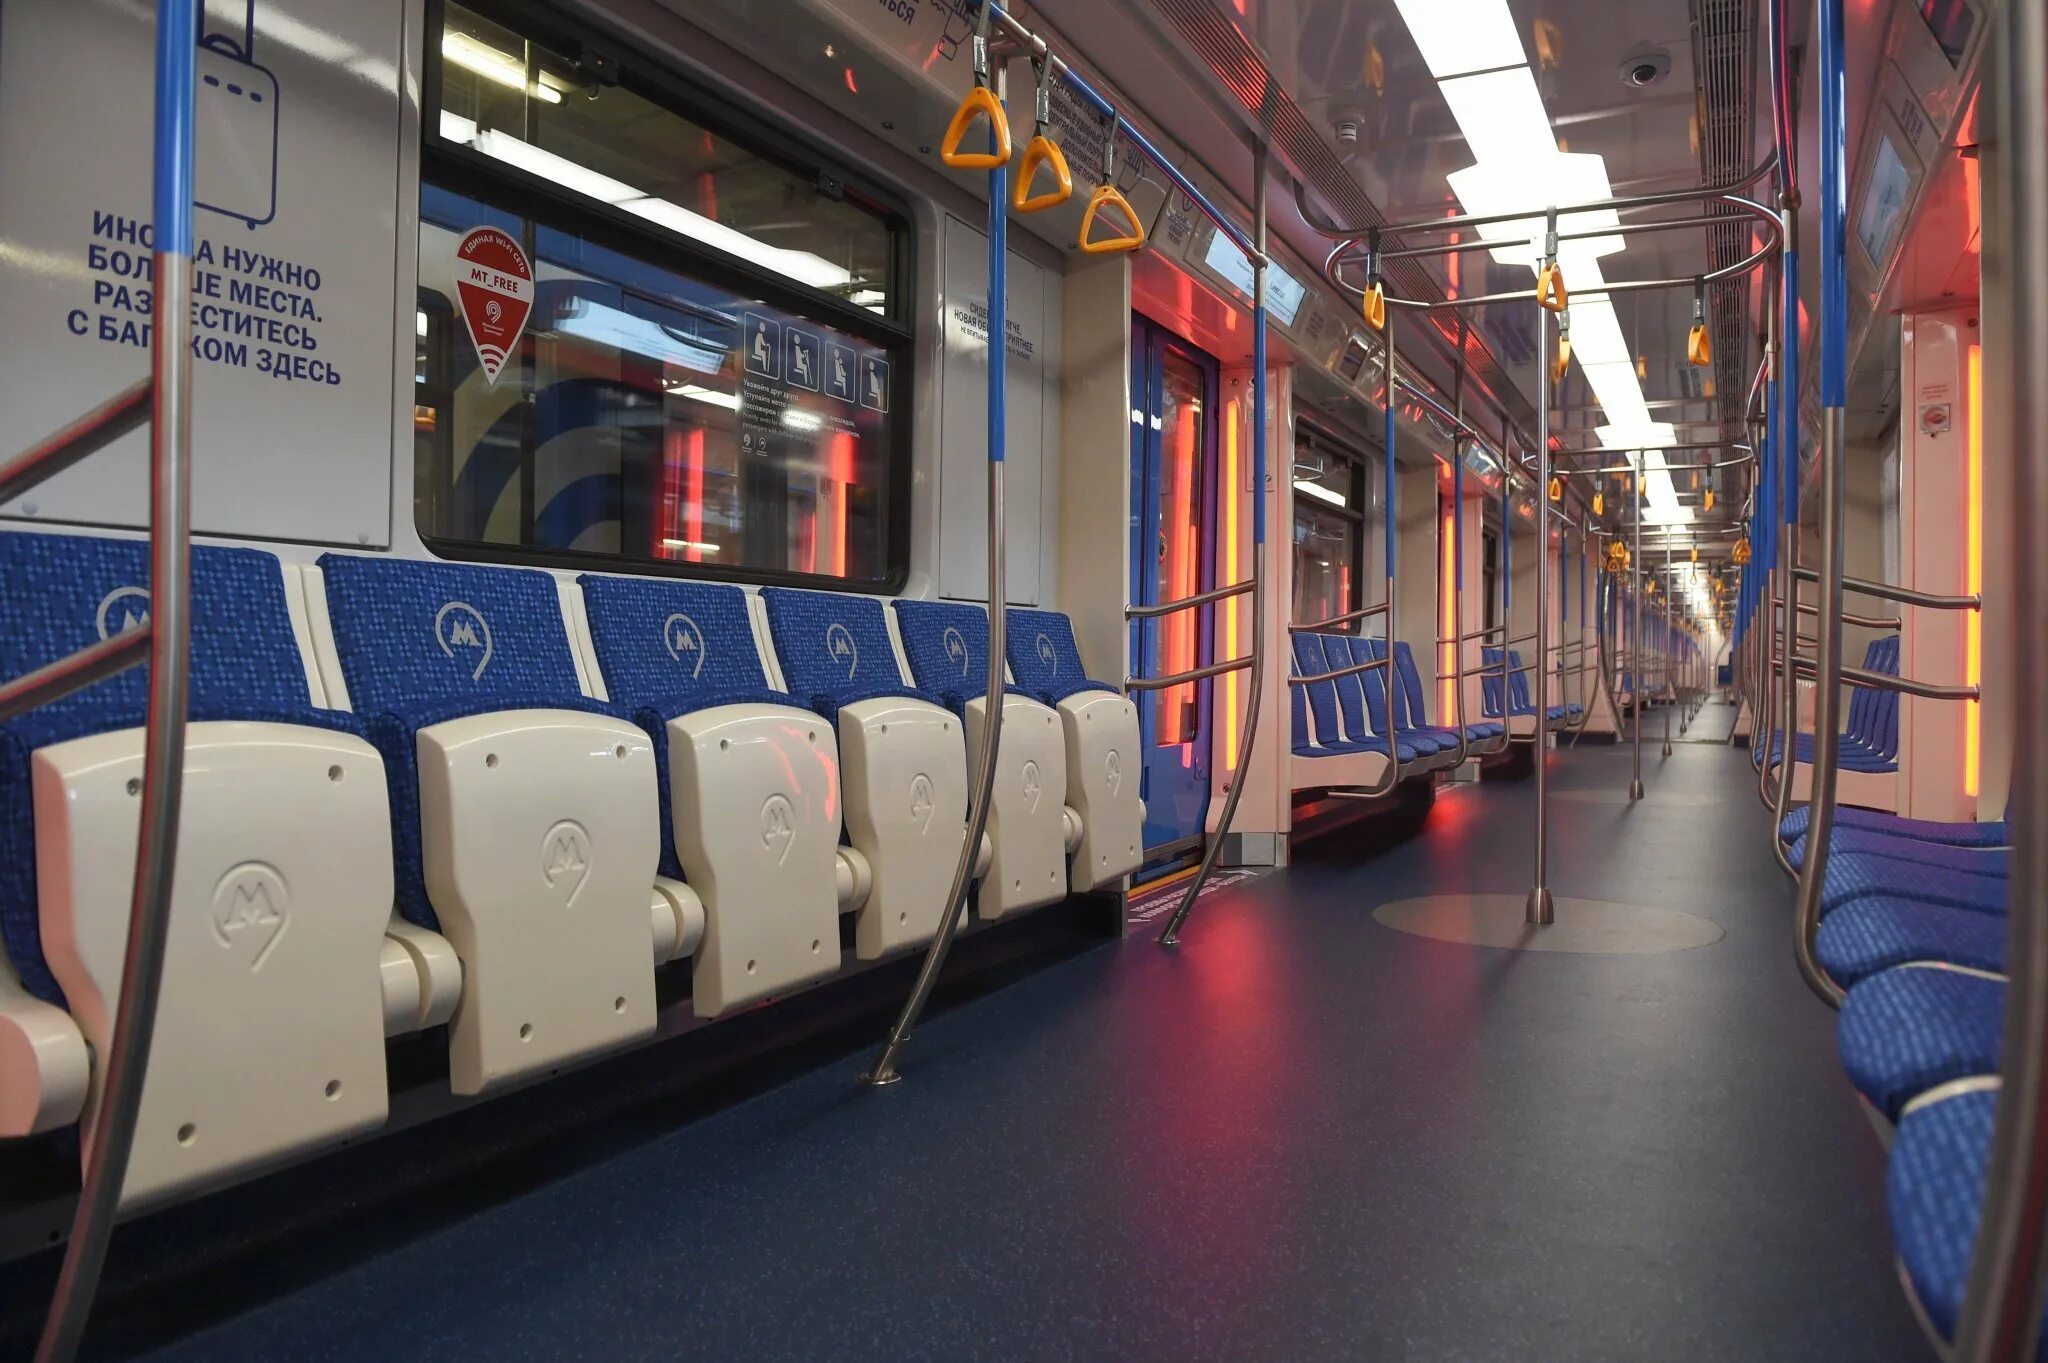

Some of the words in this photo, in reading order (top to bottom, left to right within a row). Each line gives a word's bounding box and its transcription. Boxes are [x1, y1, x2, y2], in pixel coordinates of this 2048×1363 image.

[93, 210, 215, 265] ИНОА
[222, 245, 321, 291] НУЖНО
[465, 235, 494, 254] ЕДИНАЯ
[496, 236, 513, 254] WI-FI
[513, 252, 525, 273] СЕТЬ
[88, 244, 221, 299] БОЛЕ
[229, 279, 324, 323] МЕСТА.
[471, 268, 518, 293] MT_FREE
[94, 280, 317, 351] РАЗЕСТИТЕСЬ
[954, 309, 977, 328] НОВАЯ
[67, 309, 89, 336] С
[99, 315, 247, 368] БАГОМ
[255, 348, 341, 386] ЗДЕСЬ
[743, 389, 771, 404] Уступайте
